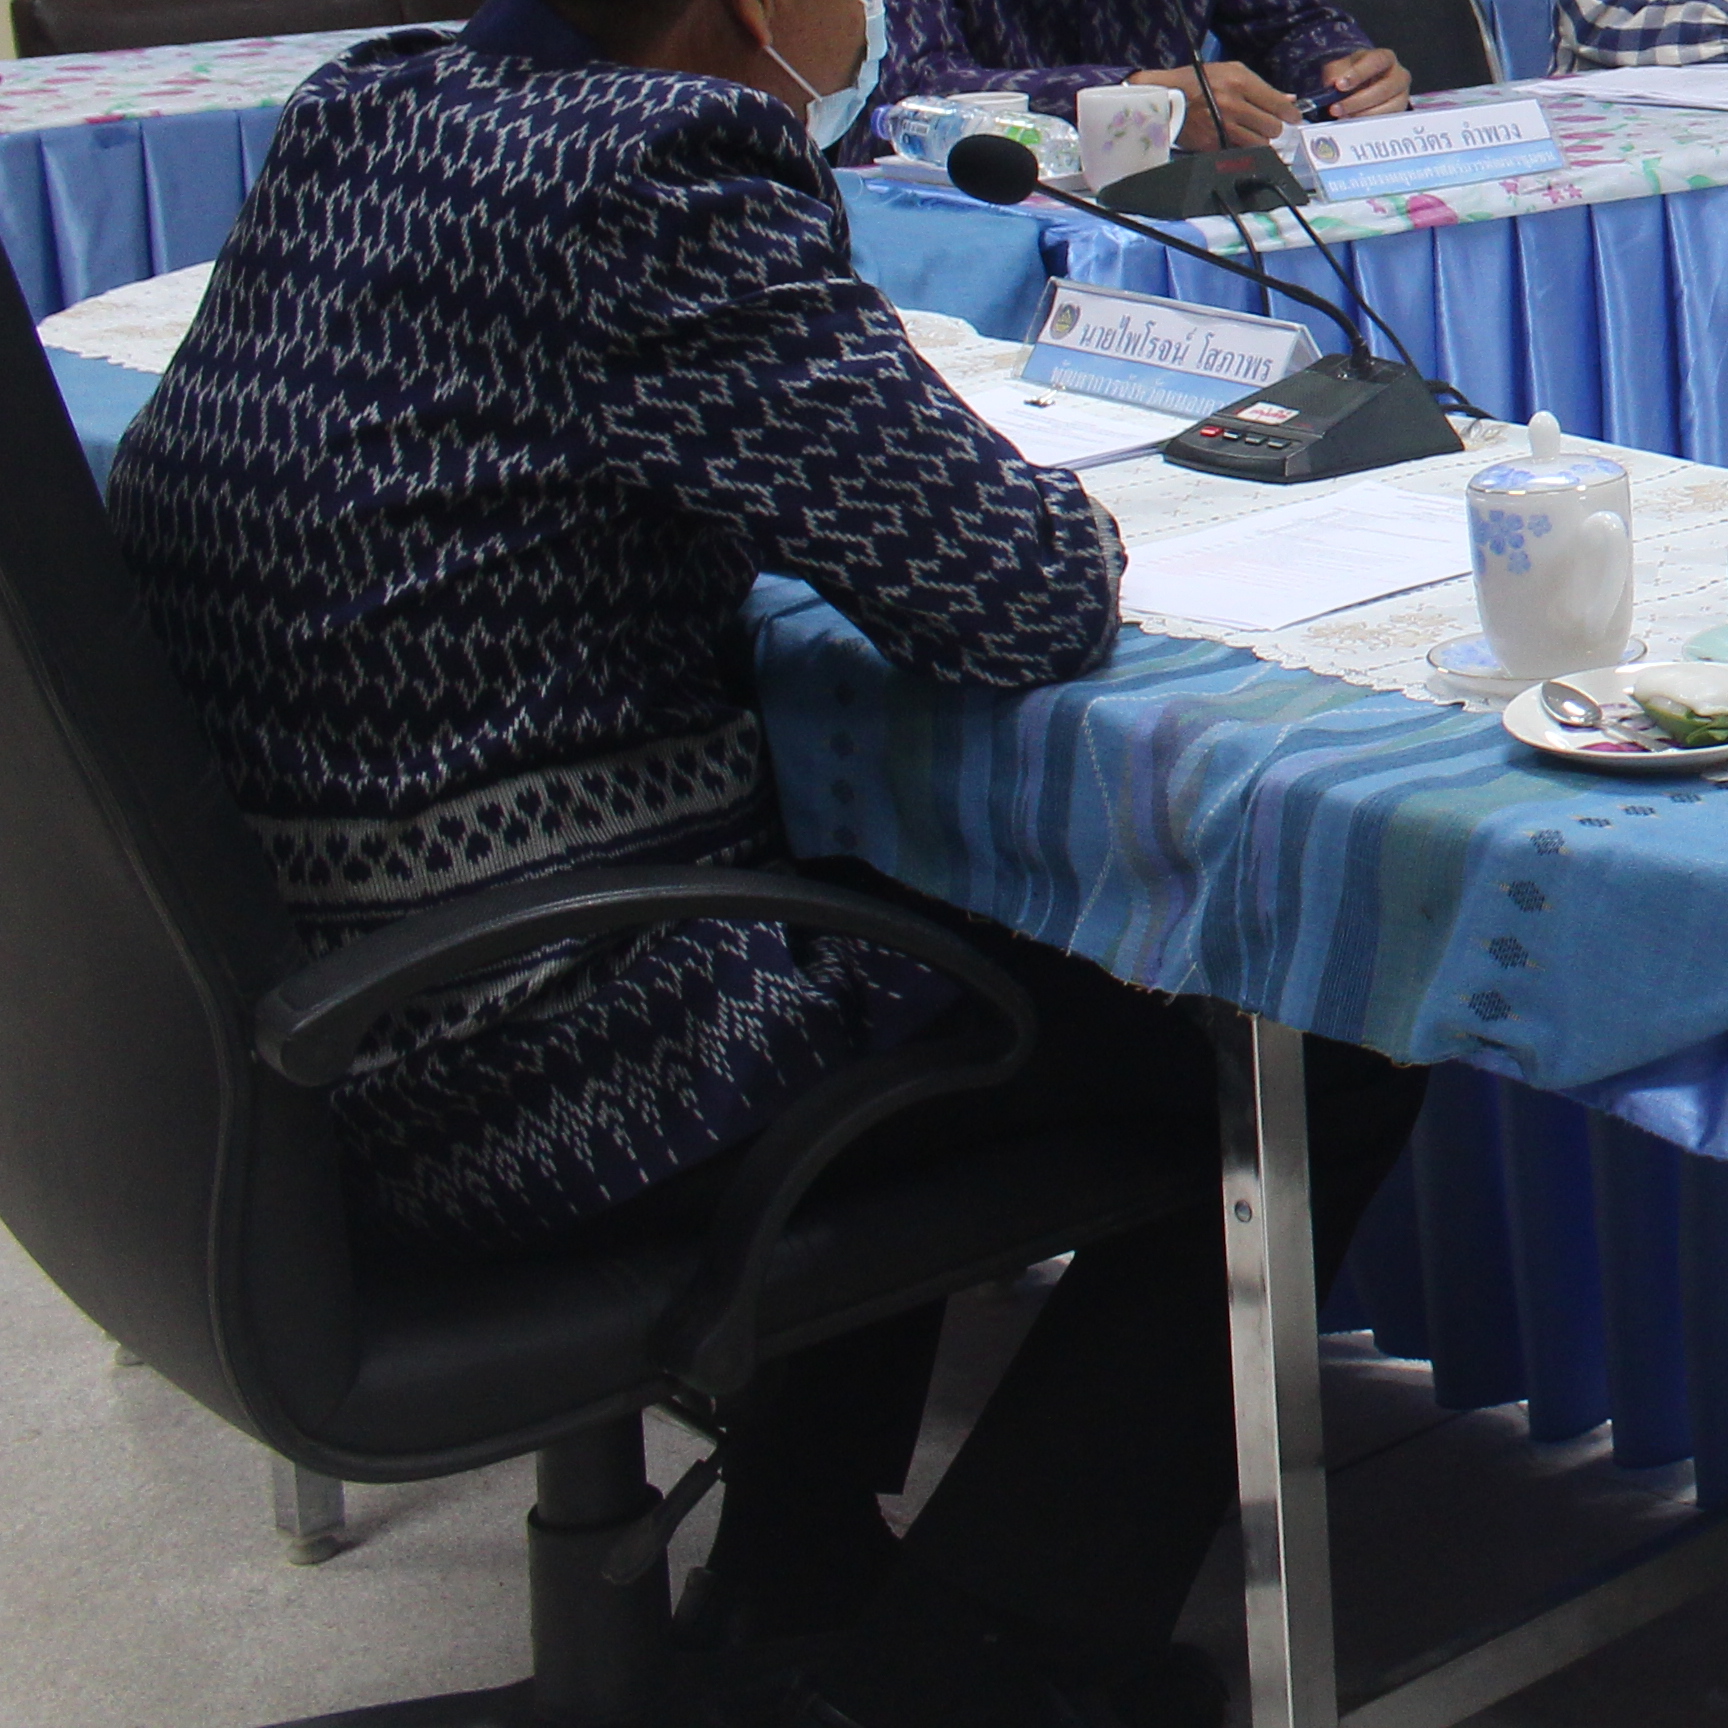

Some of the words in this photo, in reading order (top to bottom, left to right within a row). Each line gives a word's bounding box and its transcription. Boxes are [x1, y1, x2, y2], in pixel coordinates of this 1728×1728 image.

[1350, 125, 1453, 161] นายภควัตร
[1461, 121, 1522, 147] คำพวง
[1079, 315, 1198, 365] นายไพโรจน์
[1199, 331, 1274, 382] โสภาพร
